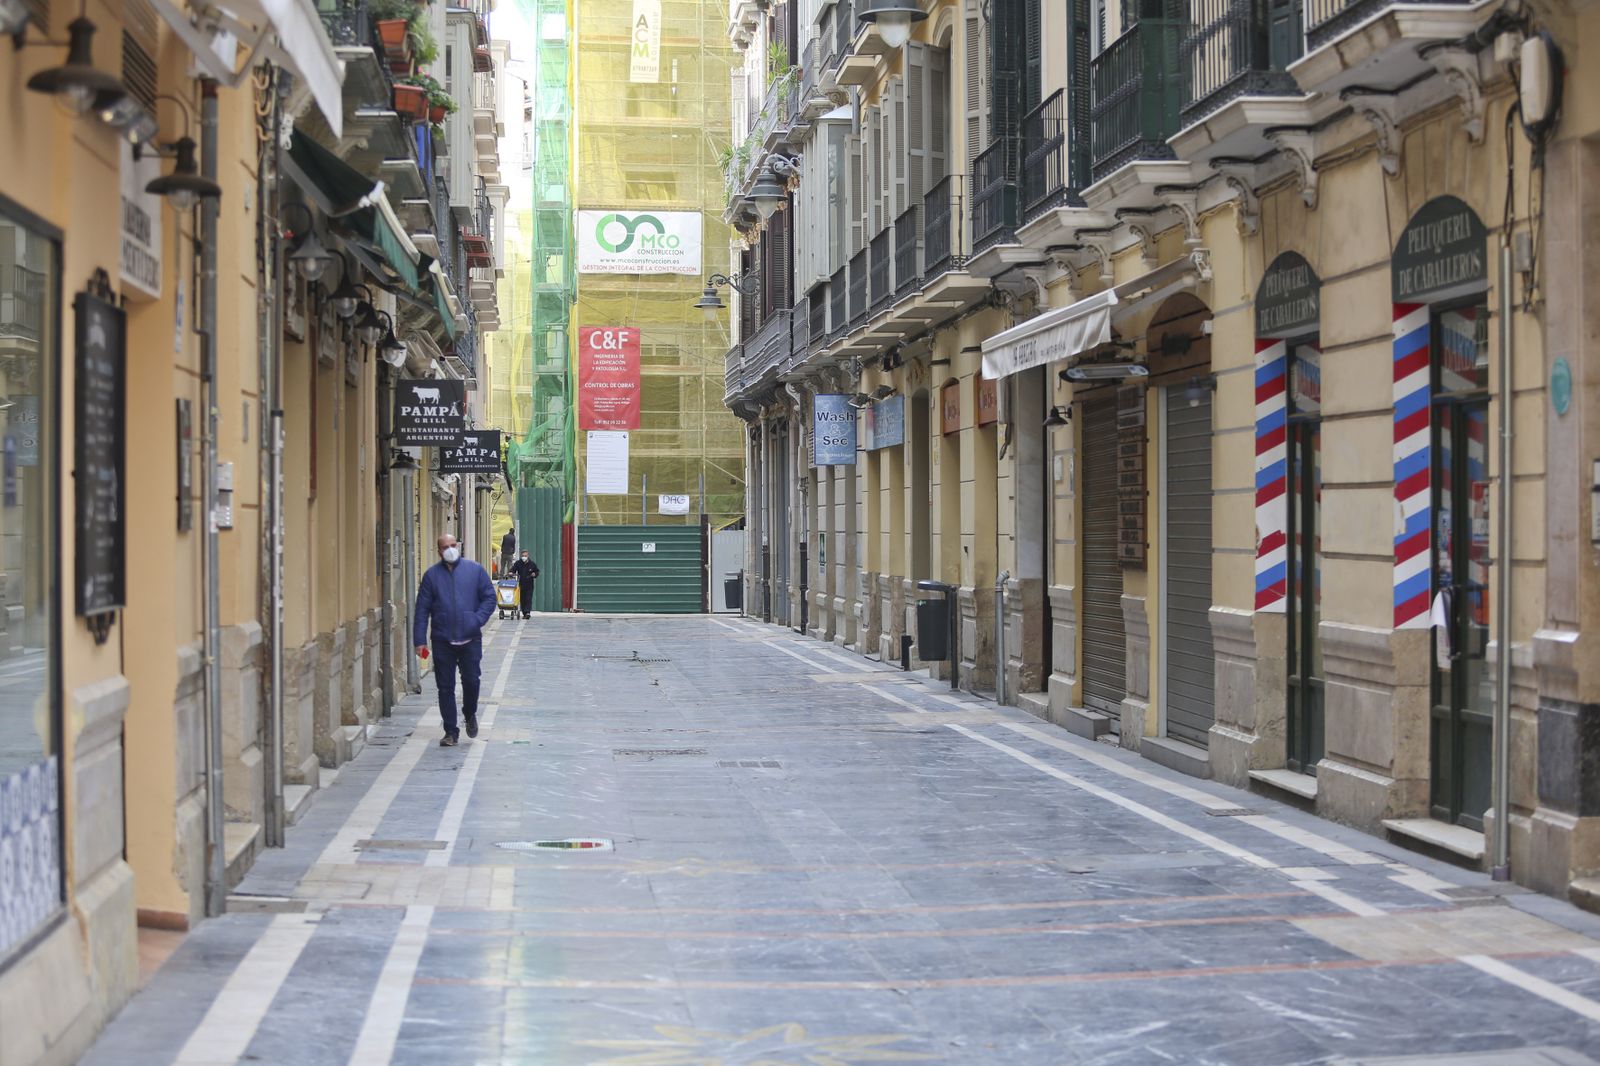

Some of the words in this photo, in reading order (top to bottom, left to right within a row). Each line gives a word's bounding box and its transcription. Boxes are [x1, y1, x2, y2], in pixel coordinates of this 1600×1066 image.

[1408, 212, 1471, 254] PELUQUERIA
[641, 234, 680, 249] MCO
[1399, 268, 1413, 295] DE
[1413, 248, 1481, 292] CABALLEROS
[1260, 308, 1270, 331] DE
[1270, 292, 1316, 328] CABALLEROS
[589, 331, 630, 349] C&F
[401, 406, 460, 416] PAMPA
[816, 411, 854, 422] Wash
[823, 435, 848, 446] Sec
[444, 448, 498, 458] PAMPA
